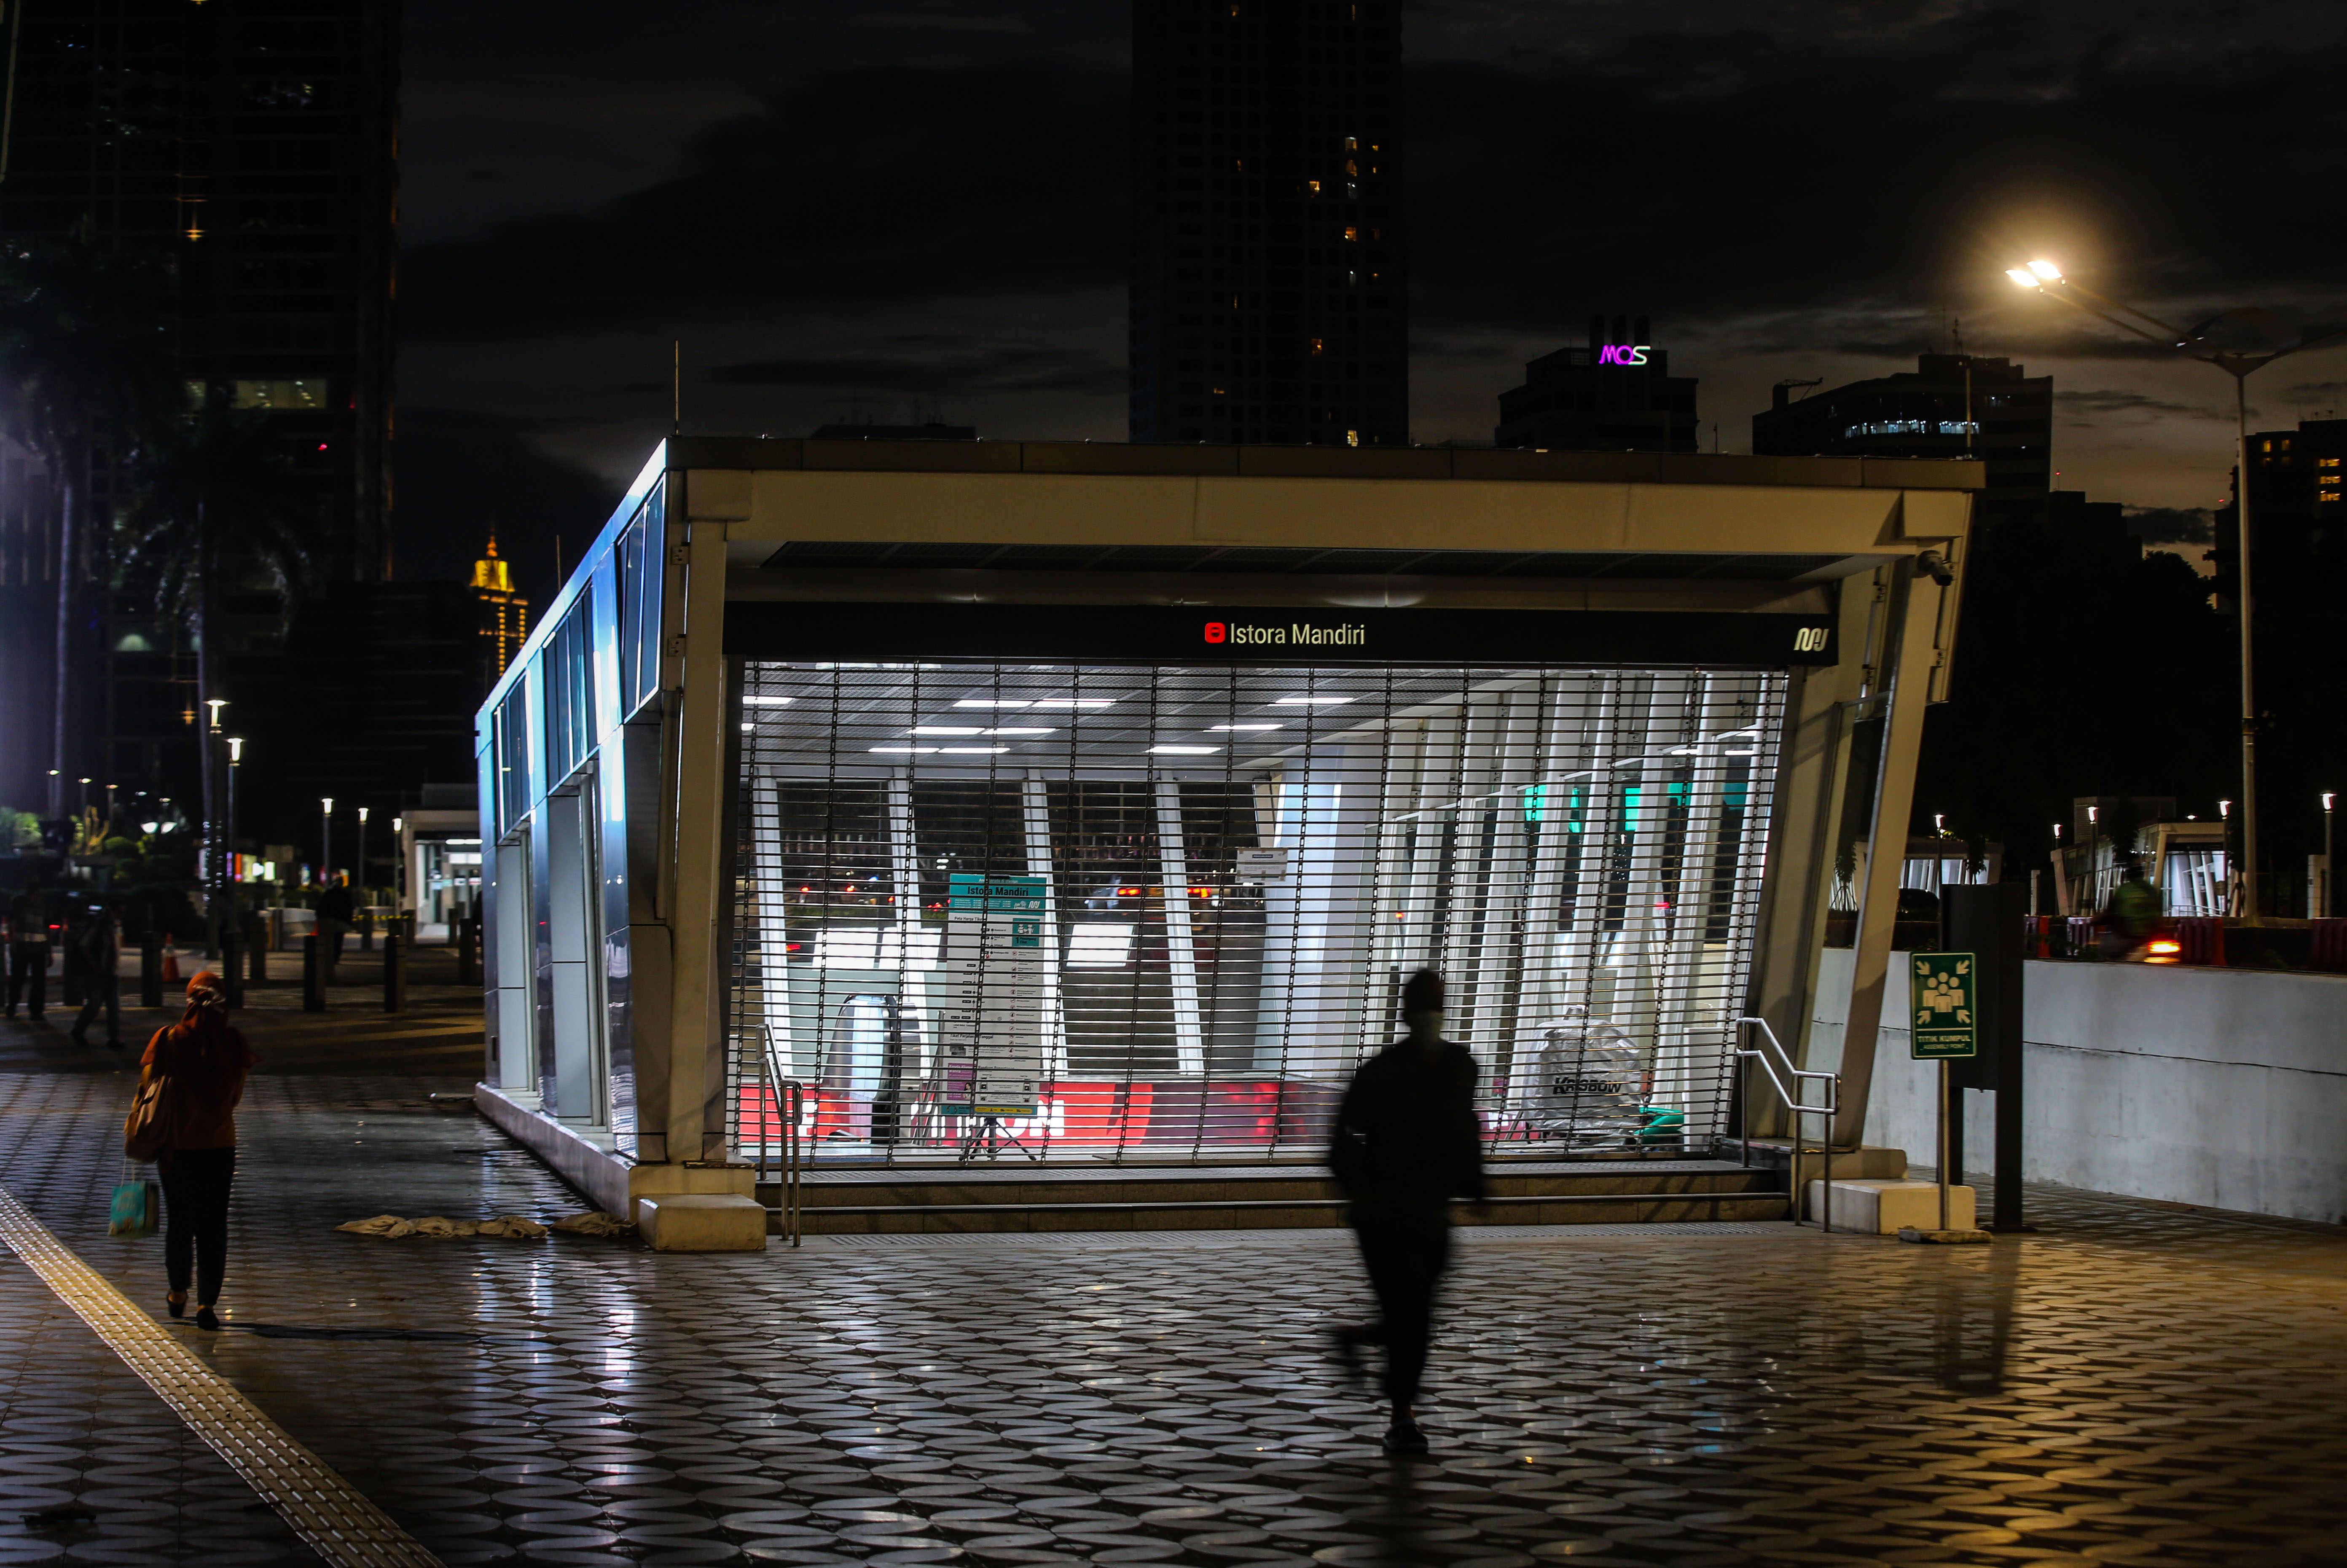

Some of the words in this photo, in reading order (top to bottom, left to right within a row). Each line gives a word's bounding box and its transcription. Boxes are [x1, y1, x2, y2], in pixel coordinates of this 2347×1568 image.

[1598, 345, 1651, 365] MOS
[1230, 623, 1285, 644] Istora
[1293, 623, 1365, 644] Mandiri
[996, 886, 1028, 896] Mandiri
